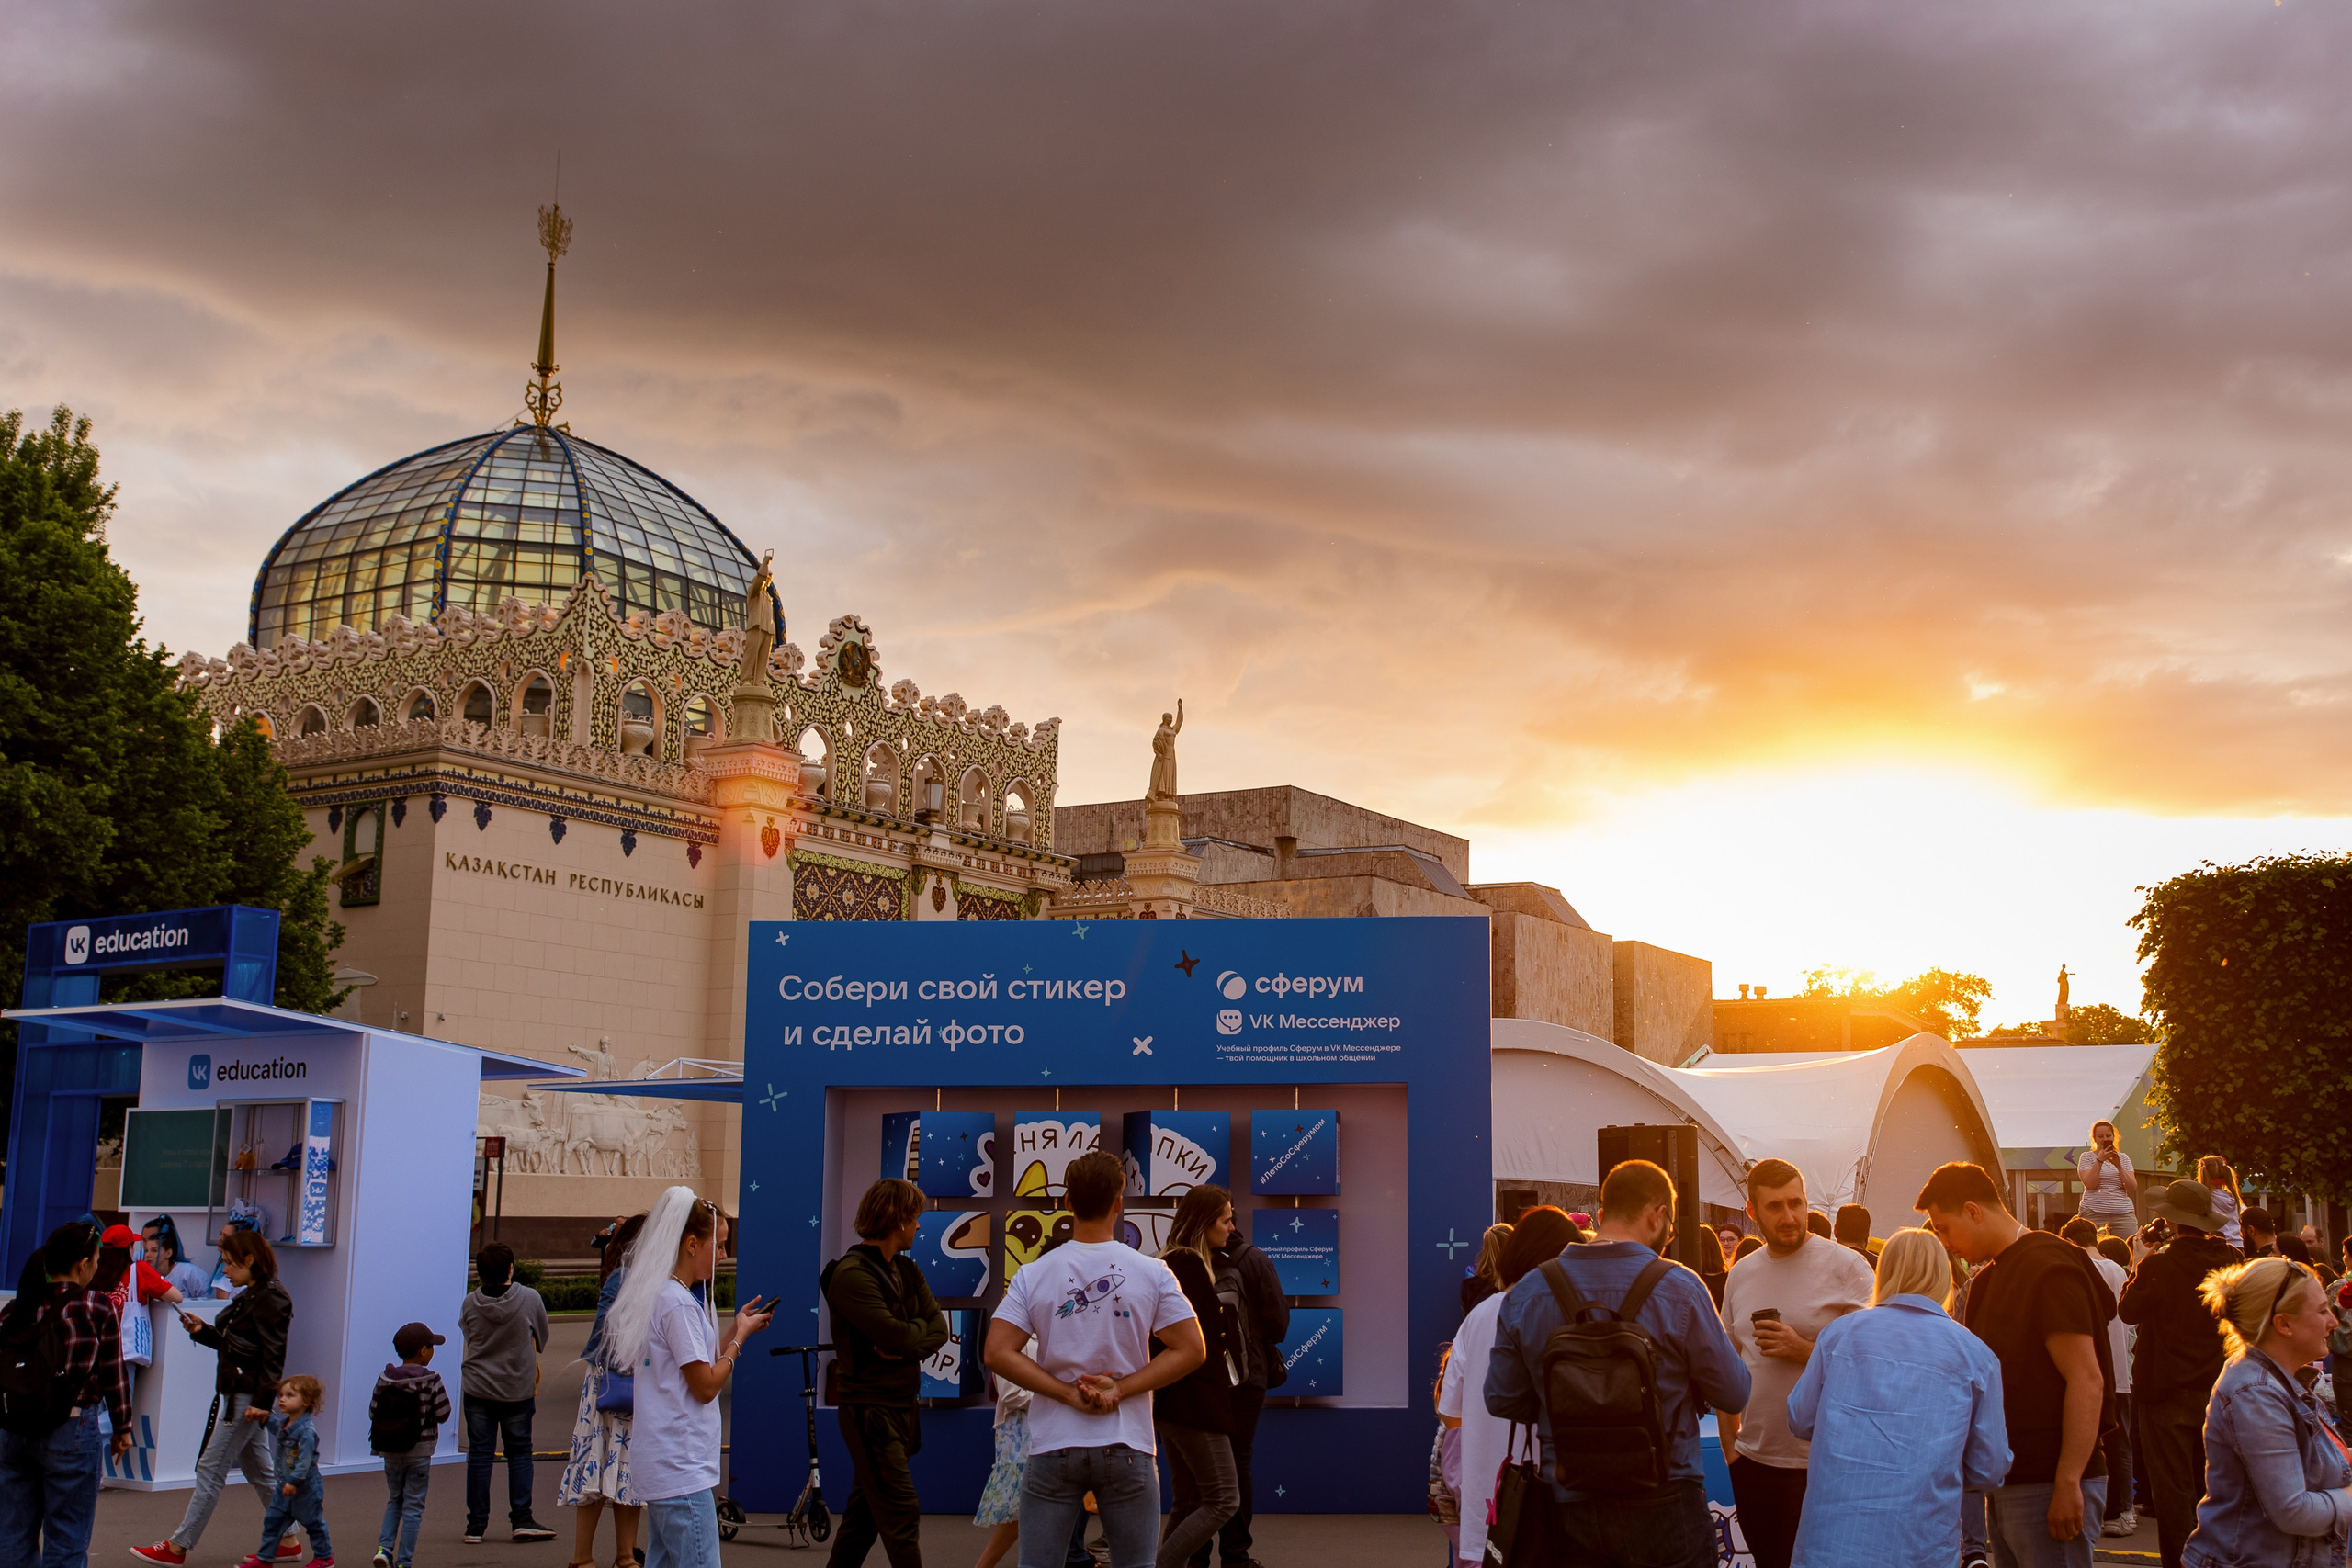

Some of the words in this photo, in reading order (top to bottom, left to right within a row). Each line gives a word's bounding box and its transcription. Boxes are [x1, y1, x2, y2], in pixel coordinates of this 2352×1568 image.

[446, 852, 557, 885] ҚАЗАҚСТАН
[569, 873, 705, 908] РЕСПУБЛИКАСЫ
[95, 923, 188, 954] education
[778, 975, 908, 1008] Собери
[918, 973, 998, 1000] свой
[1007, 978, 1126, 1007] стикер
[1254, 972, 1363, 998] сферум
[784, 1025, 802, 1045] и
[812, 1018, 932, 1051] сделай
[941, 1019, 1025, 1052] фото
[1250, 1014, 1274, 1029] VK
[1279, 1014, 1401, 1032] Мессенджер
[1216, 1043, 1251, 1053] Учебный
[1253, 1044, 1288, 1053] профиль
[1290, 1043, 1323, 1053] Сферум
[1342, 1043, 1401, 1053] Мессенджере
[1225, 1054, 1244, 1062] твой
[1339, 1054, 1376, 1063] общении
[217, 1056, 307, 1081] education
[1014, 1128, 1057, 1155] НЯ
[1150, 1132, 1208, 1180] ПКИ
[1260, 1118, 1326, 1185] #ЛетоСоСферумом
[1283, 1325, 1328, 1370] ойСферум
